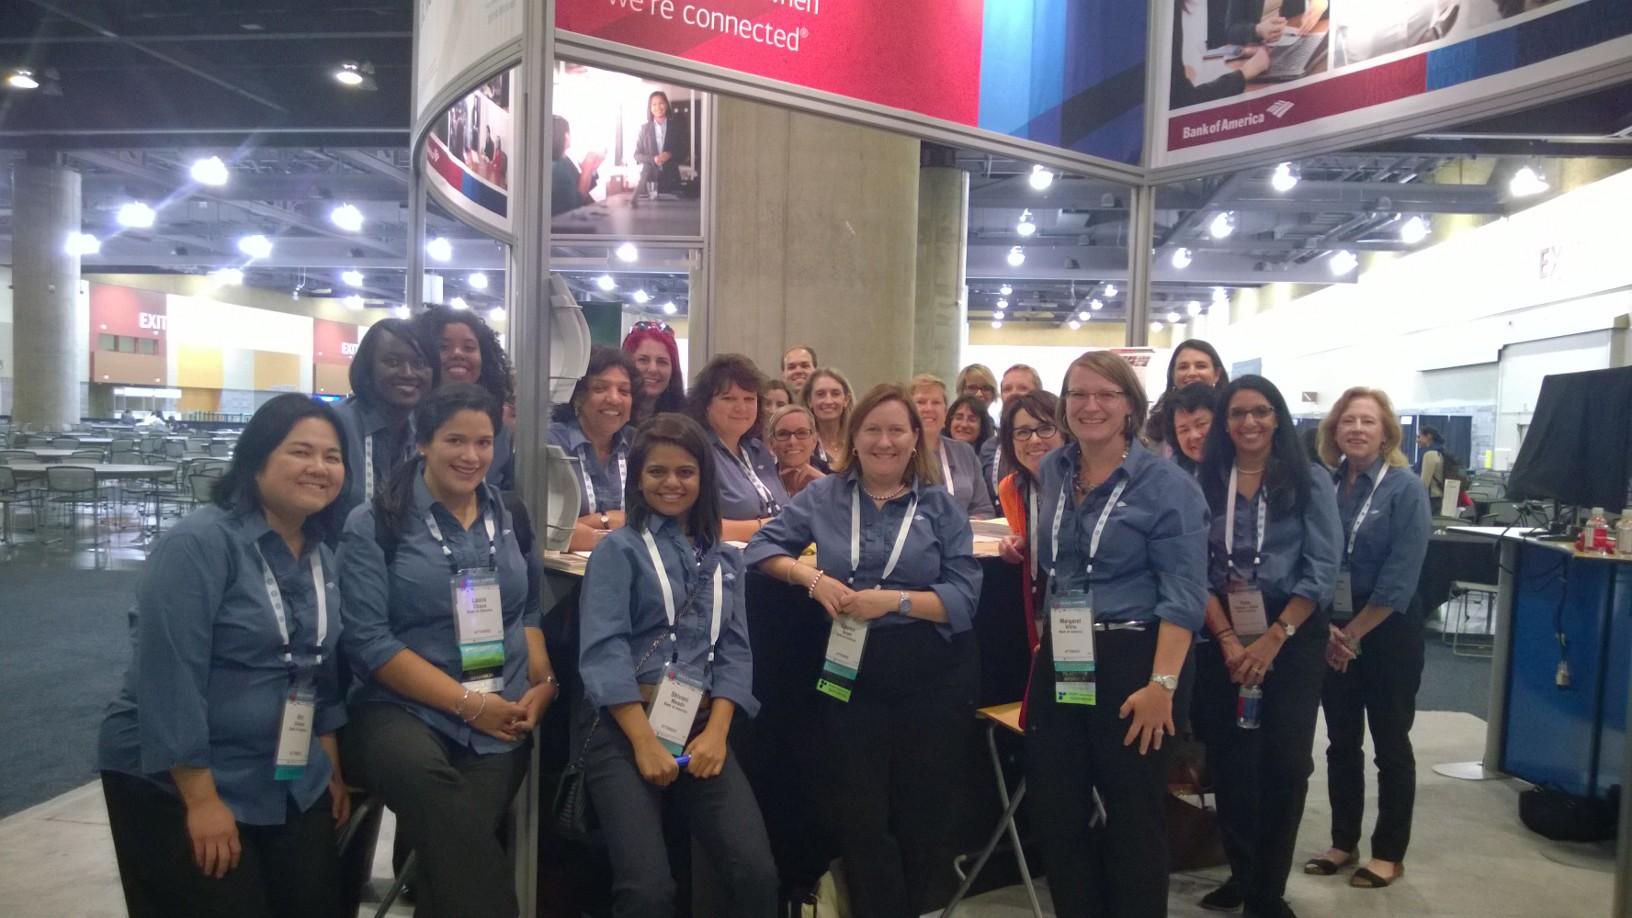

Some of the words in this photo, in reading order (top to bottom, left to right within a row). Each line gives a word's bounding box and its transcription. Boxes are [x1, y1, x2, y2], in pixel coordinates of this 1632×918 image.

[1182, 123, 1209, 139] Bank
[1209, 118, 1220, 133] of
[1221, 112, 1265, 131] America
[140, 313, 167, 331] EXIT
